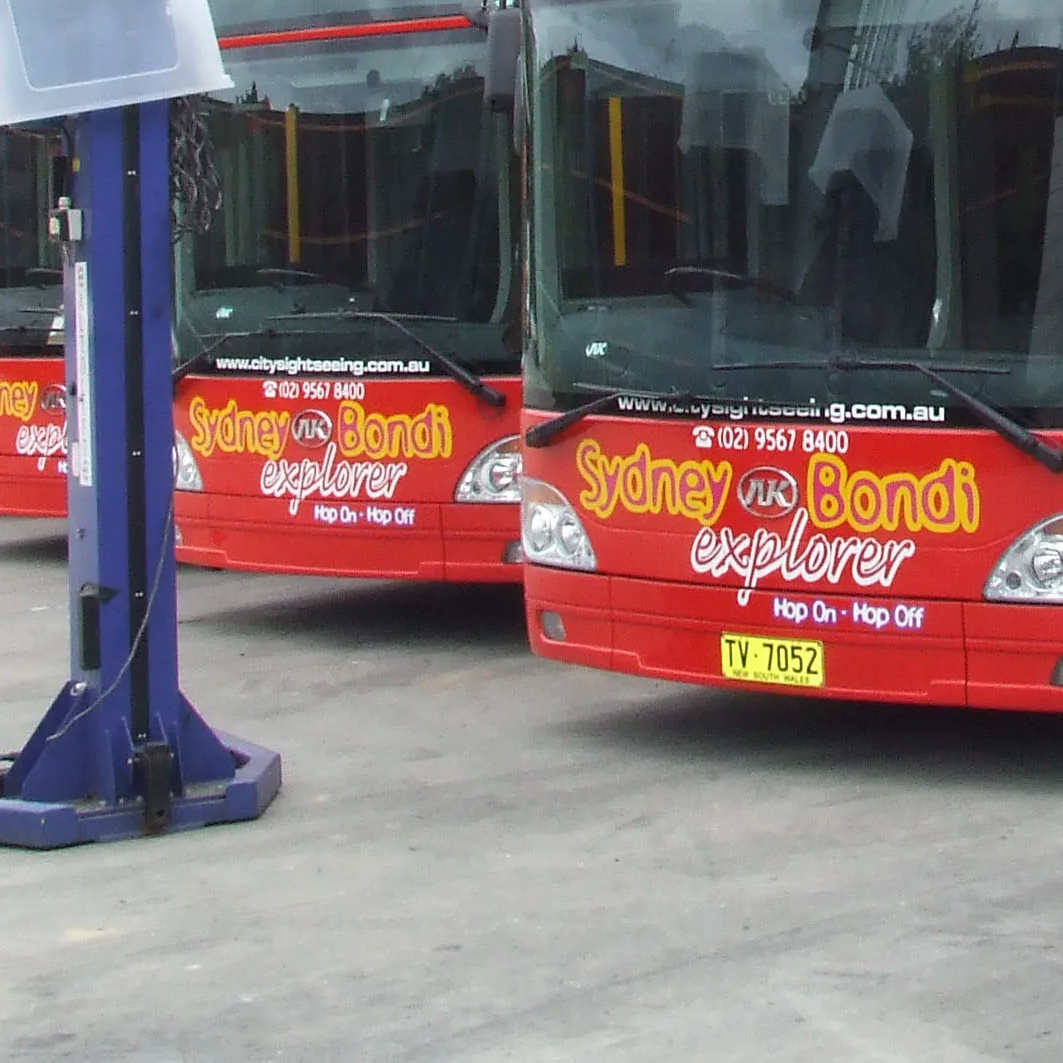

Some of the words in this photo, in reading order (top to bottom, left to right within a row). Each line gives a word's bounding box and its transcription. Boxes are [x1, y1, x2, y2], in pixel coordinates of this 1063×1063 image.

[216, 355, 430, 376] www.citysightseeing.com.au
[279, 382, 300, 399] (02)
[302, 382, 330, 399] 9567
[333, 383, 365, 400] 8400
[189, 397, 290, 460] Sydney
[337, 400, 453, 460] Bondi
[717, 427, 748, 450] (02)
[756, 428, 797, 451] 9567
[802, 430, 848, 454] 8400
[260, 442, 407, 515] explorer
[576, 438, 732, 527] Sydney
[807, 453, 982, 534] Bondi
[314, 505, 338, 523] Hop
[340, 507, 357, 523] On
[367, 506, 392, 525] Hop
[394, 508, 415, 524] Off
[690, 508, 916, 606] explorer
[773, 597, 808, 623] Hop
[812, 601, 837, 623] On
[853, 602, 889, 629] Hop
[895, 605, 925, 628] Off
[725, 639, 749, 668] TV
[763, 643, 818, 675] 7052
[753, 672, 780, 681] SOUTH
[784, 675, 810, 684] WALES
